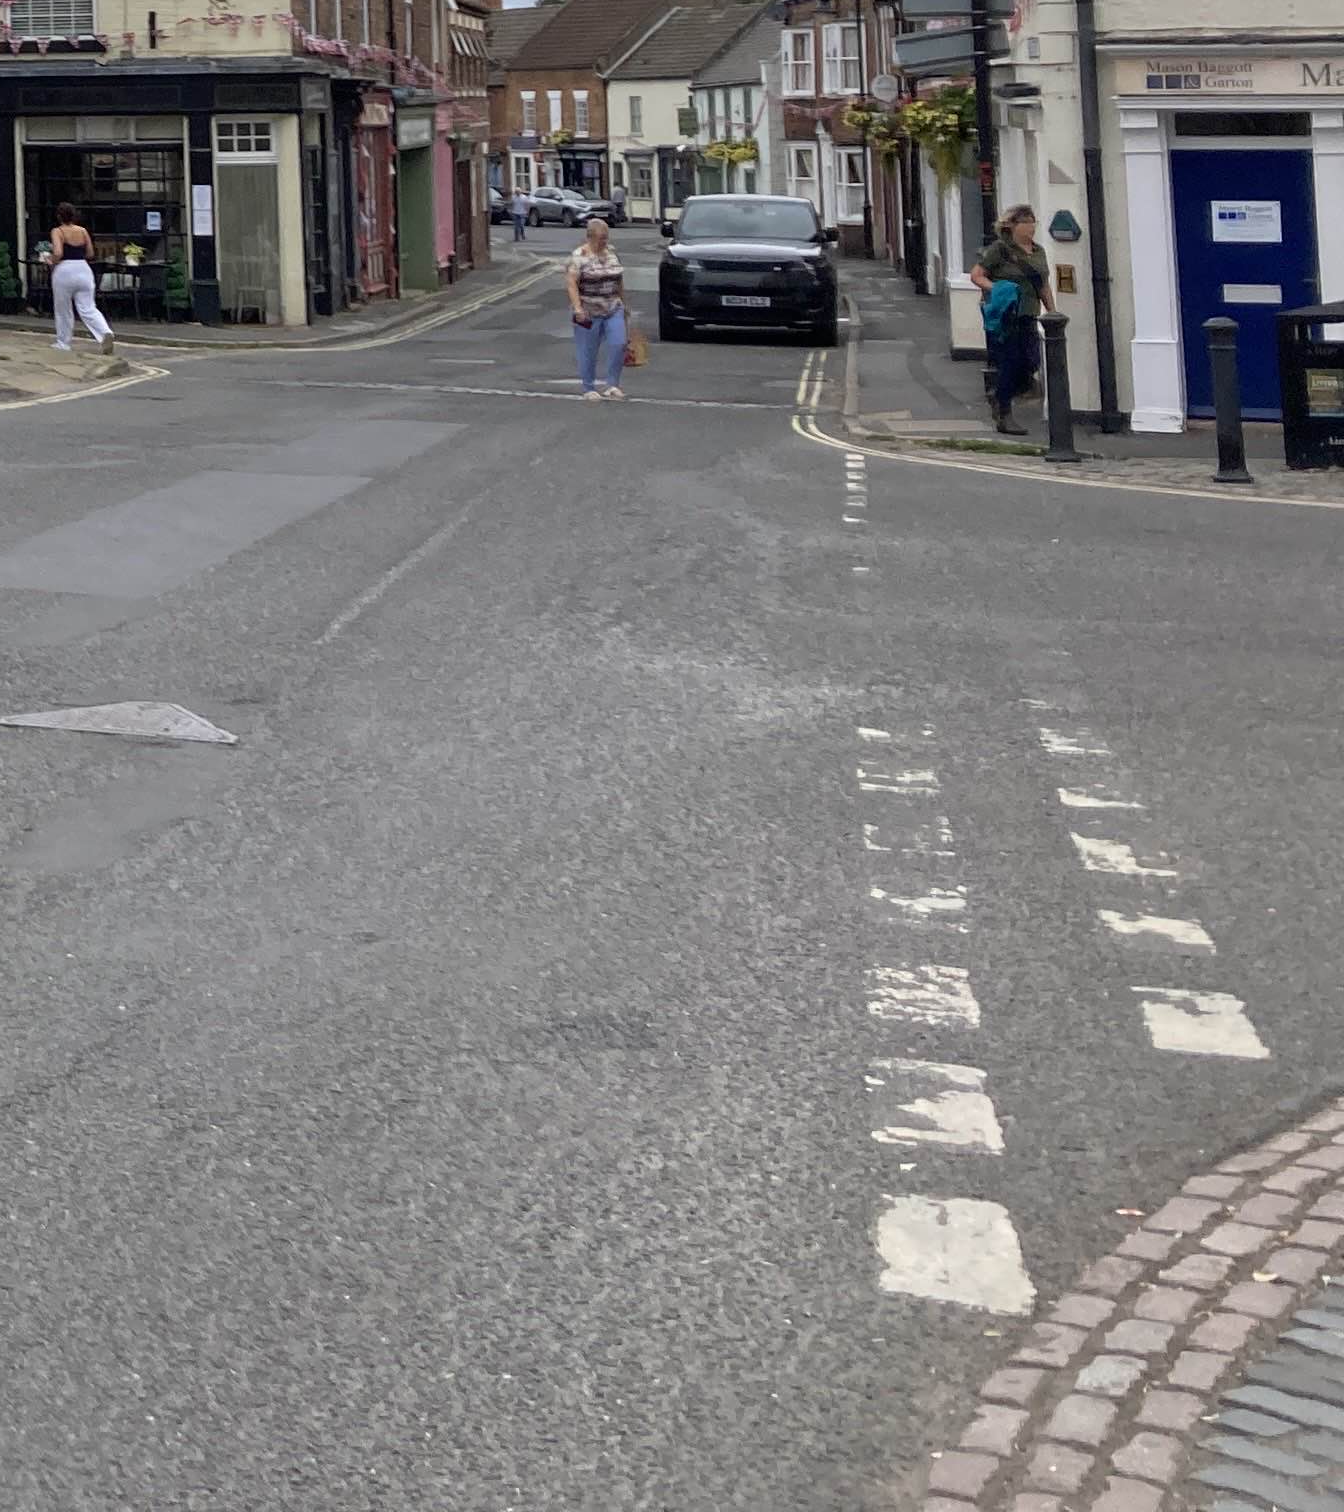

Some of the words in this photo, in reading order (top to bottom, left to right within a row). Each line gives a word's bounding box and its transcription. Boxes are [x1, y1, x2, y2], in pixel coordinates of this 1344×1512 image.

[1146, 61, 1193, 73] Mason
[1198, 61, 1252, 75] Baggott
[1205, 76, 1253, 88] Garton
